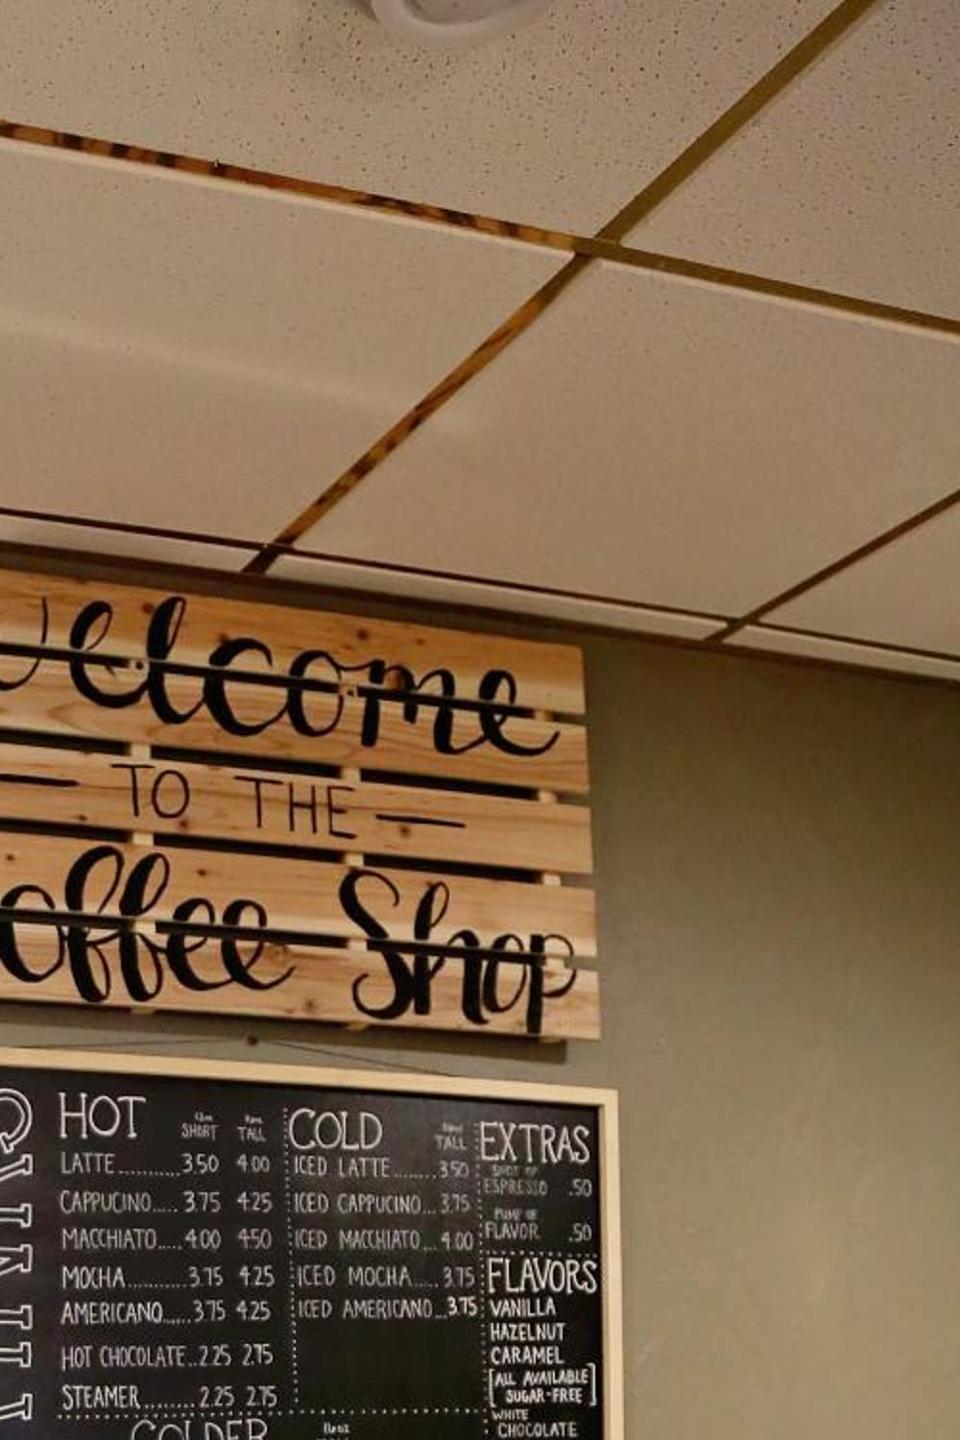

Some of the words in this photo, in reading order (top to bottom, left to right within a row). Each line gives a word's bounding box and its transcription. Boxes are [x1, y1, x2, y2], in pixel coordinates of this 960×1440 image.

[111, 763, 192, 818] TO
[233, 775, 359, 840] THE
[339, 868, 577, 1033] Shop
[58, 1092, 147, 1139] HOT
[181, 1122, 219, 1141] SHORT
[237, 1126, 267, 1142] TALL
[289, 1107, 383, 1150] COLD
[434, 1134, 467, 1151] TALL
[480, 1121, 591, 1165] EXTRAS
[60, 1151, 116, 1174] LATTE
[181, 1152, 220, 1175] 3.50
[294, 1155, 328, 1177] ICED
[339, 1156, 391, 1178] LATTE
[484, 1178, 548, 1196] ESPRESSO
[568, 1179, 593, 1198] .50
[60, 1189, 152, 1214] CAPPUCINO
[183, 1190, 222, 1214] 3.75
[294, 1191, 330, 1214] ICED
[337, 1193, 422, 1215] CAPPUCINO
[441, 1193, 471, 1214] 3.75
[62, 1228, 158, 1251] MACCHIATO
[294, 1228, 328, 1250] ICED
[339, 1229, 422, 1251] MACCHIATO
[484, 1221, 541, 1240] FLAVOR
[568, 1222, 593, 1242] .50
[62, 1265, 126, 1290] MOCHA
[297, 1264, 337, 1288] ICED
[348, 1265, 413, 1288] MOCHA
[443, 1266, 476, 1288] 3.75
[488, 1257, 598, 1295] FLAVORS
[60, 1301, 164, 1325] AMERICANO
[298, 1299, 333, 1319] ICED
[342, 1297, 434, 1320] AMERICANO
[447, 1295, 478, 1317] 3.75
[490, 1297, 557, 1318] VANILLA
[490, 1322, 567, 1342] HAZELNUT
[61, 1345, 93, 1372] HOT
[100, 1345, 187, 1368] CHOCOLATE
[243, 1343, 274, 1366] 2.75
[490, 1345, 565, 1365] CARAMEL
[495, 1371, 517, 1387] ALL
[523, 1368, 589, 1387] AVAILABLE
[62, 1384, 141, 1411] STEAMER
[505, 1387, 584, 1405] SUGAR-FREE
[492, 1408, 529, 1421] WHITE
[498, 1421, 579, 1438] CHOCOLATE
